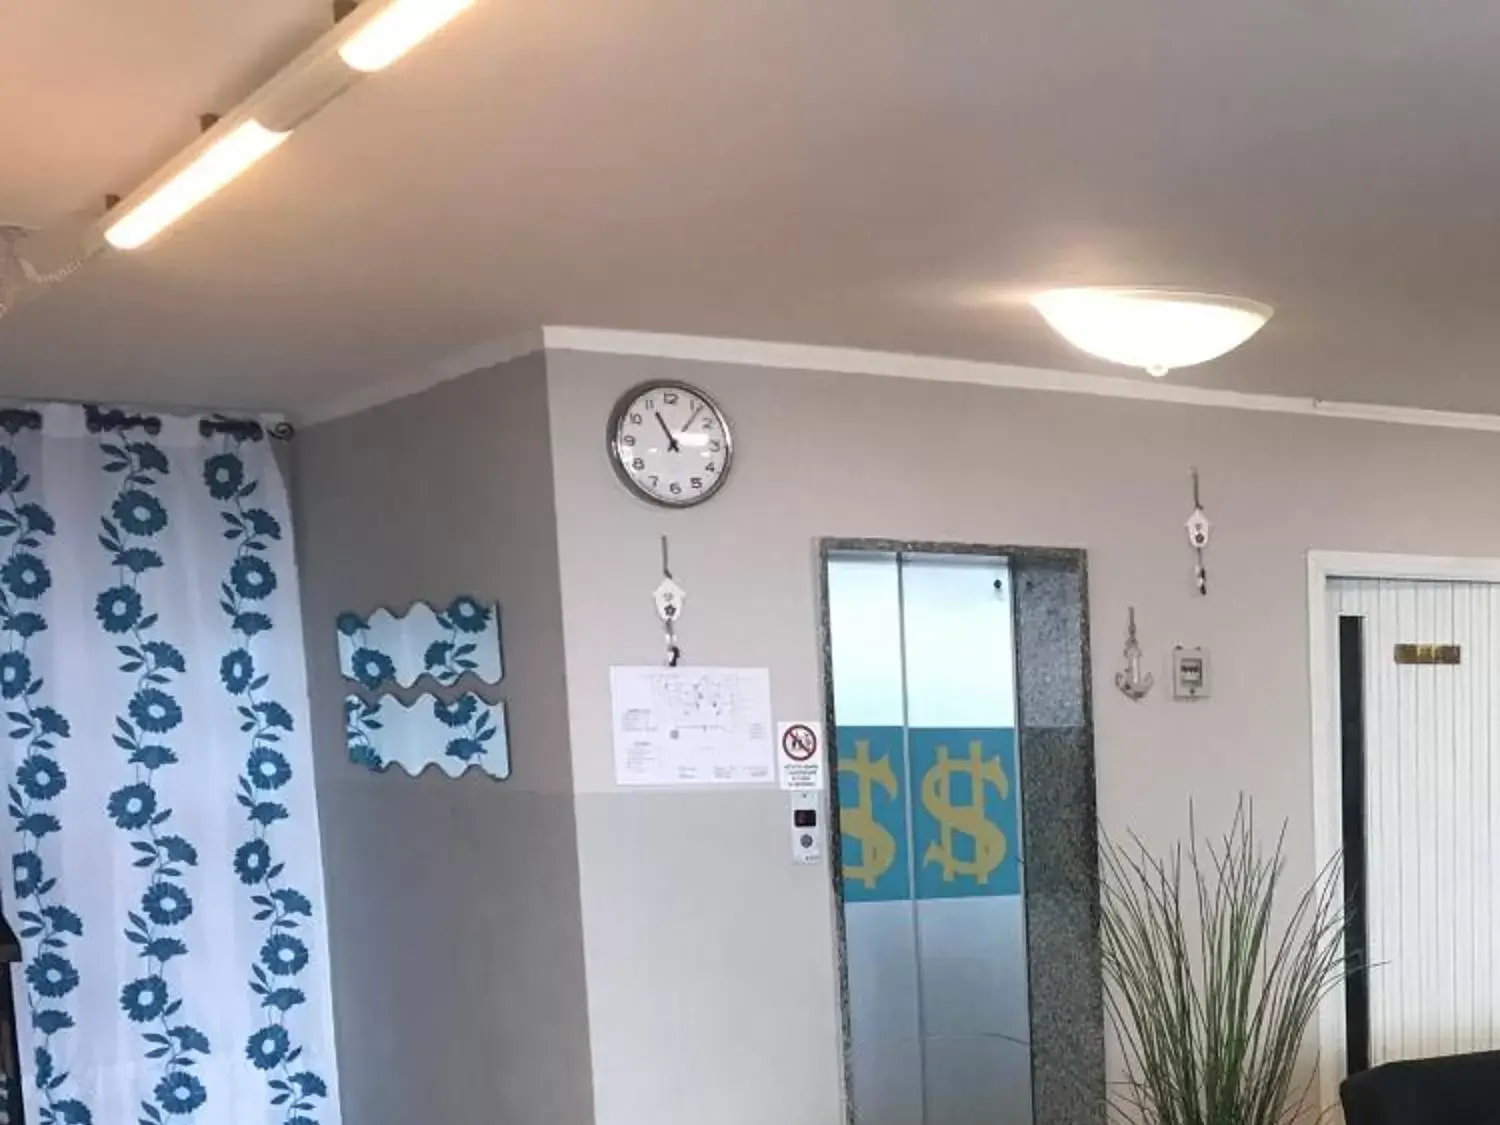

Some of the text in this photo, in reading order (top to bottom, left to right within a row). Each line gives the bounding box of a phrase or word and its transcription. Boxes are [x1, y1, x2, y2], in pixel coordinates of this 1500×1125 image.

[645, 399, 655, 411] 11
[663, 393, 679, 405] 12
[630, 412, 642, 425] 10
[702, 417, 713, 429] 2
[623, 434, 636, 447] 9
[709, 439, 720, 453] 3
[632, 457, 645, 471] 8
[705, 461, 716, 473] 4
[648, 475, 659, 487] 7
[690, 476, 703, 489] 5
[669, 482, 682, 495] 6
